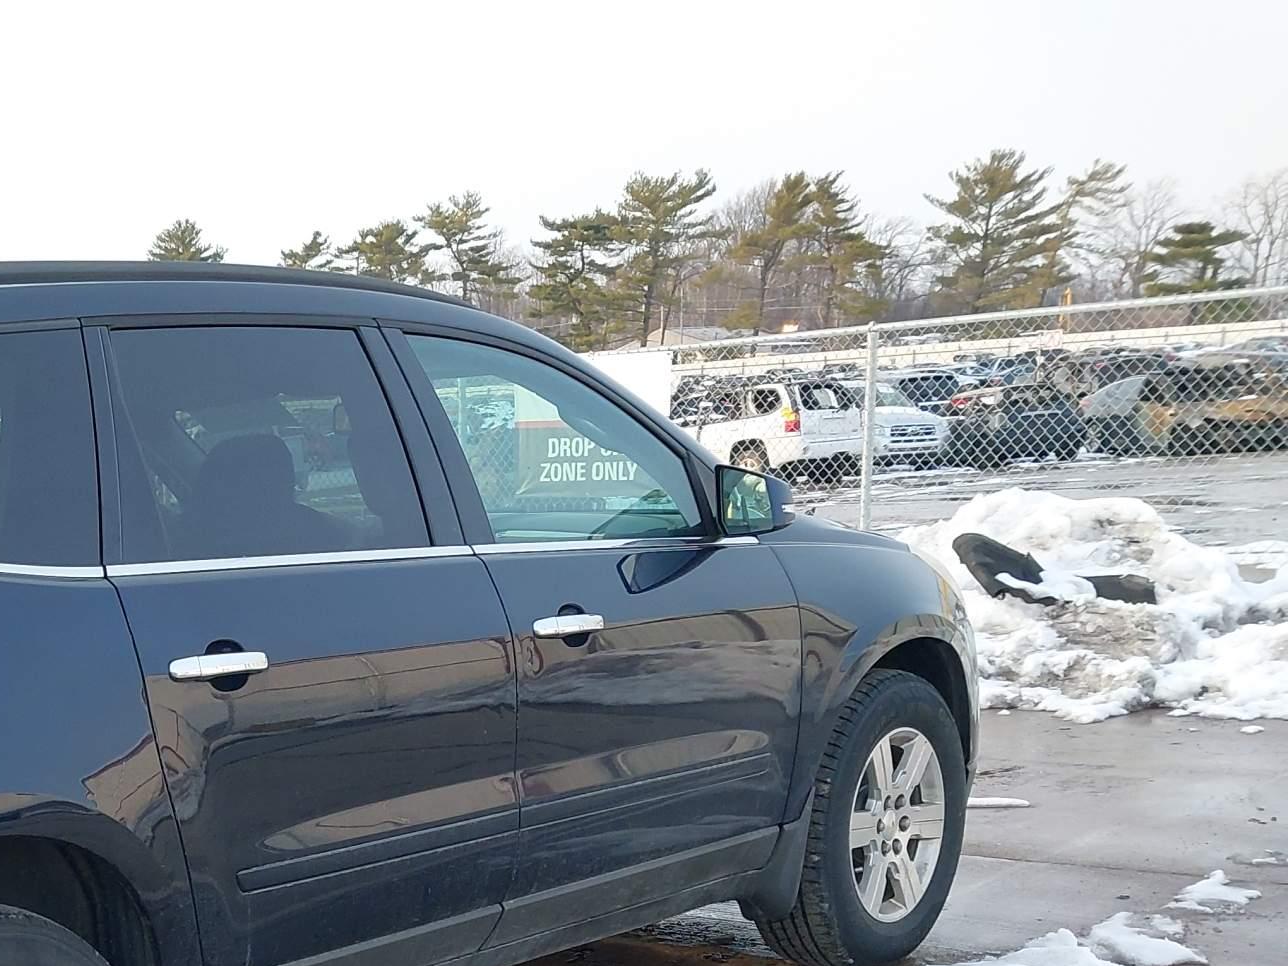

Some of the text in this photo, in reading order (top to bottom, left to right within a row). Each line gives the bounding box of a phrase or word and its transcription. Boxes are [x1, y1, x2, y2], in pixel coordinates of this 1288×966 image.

[547, 437, 596, 458] DROP
[539, 461, 638, 482] ZONE ONLY
